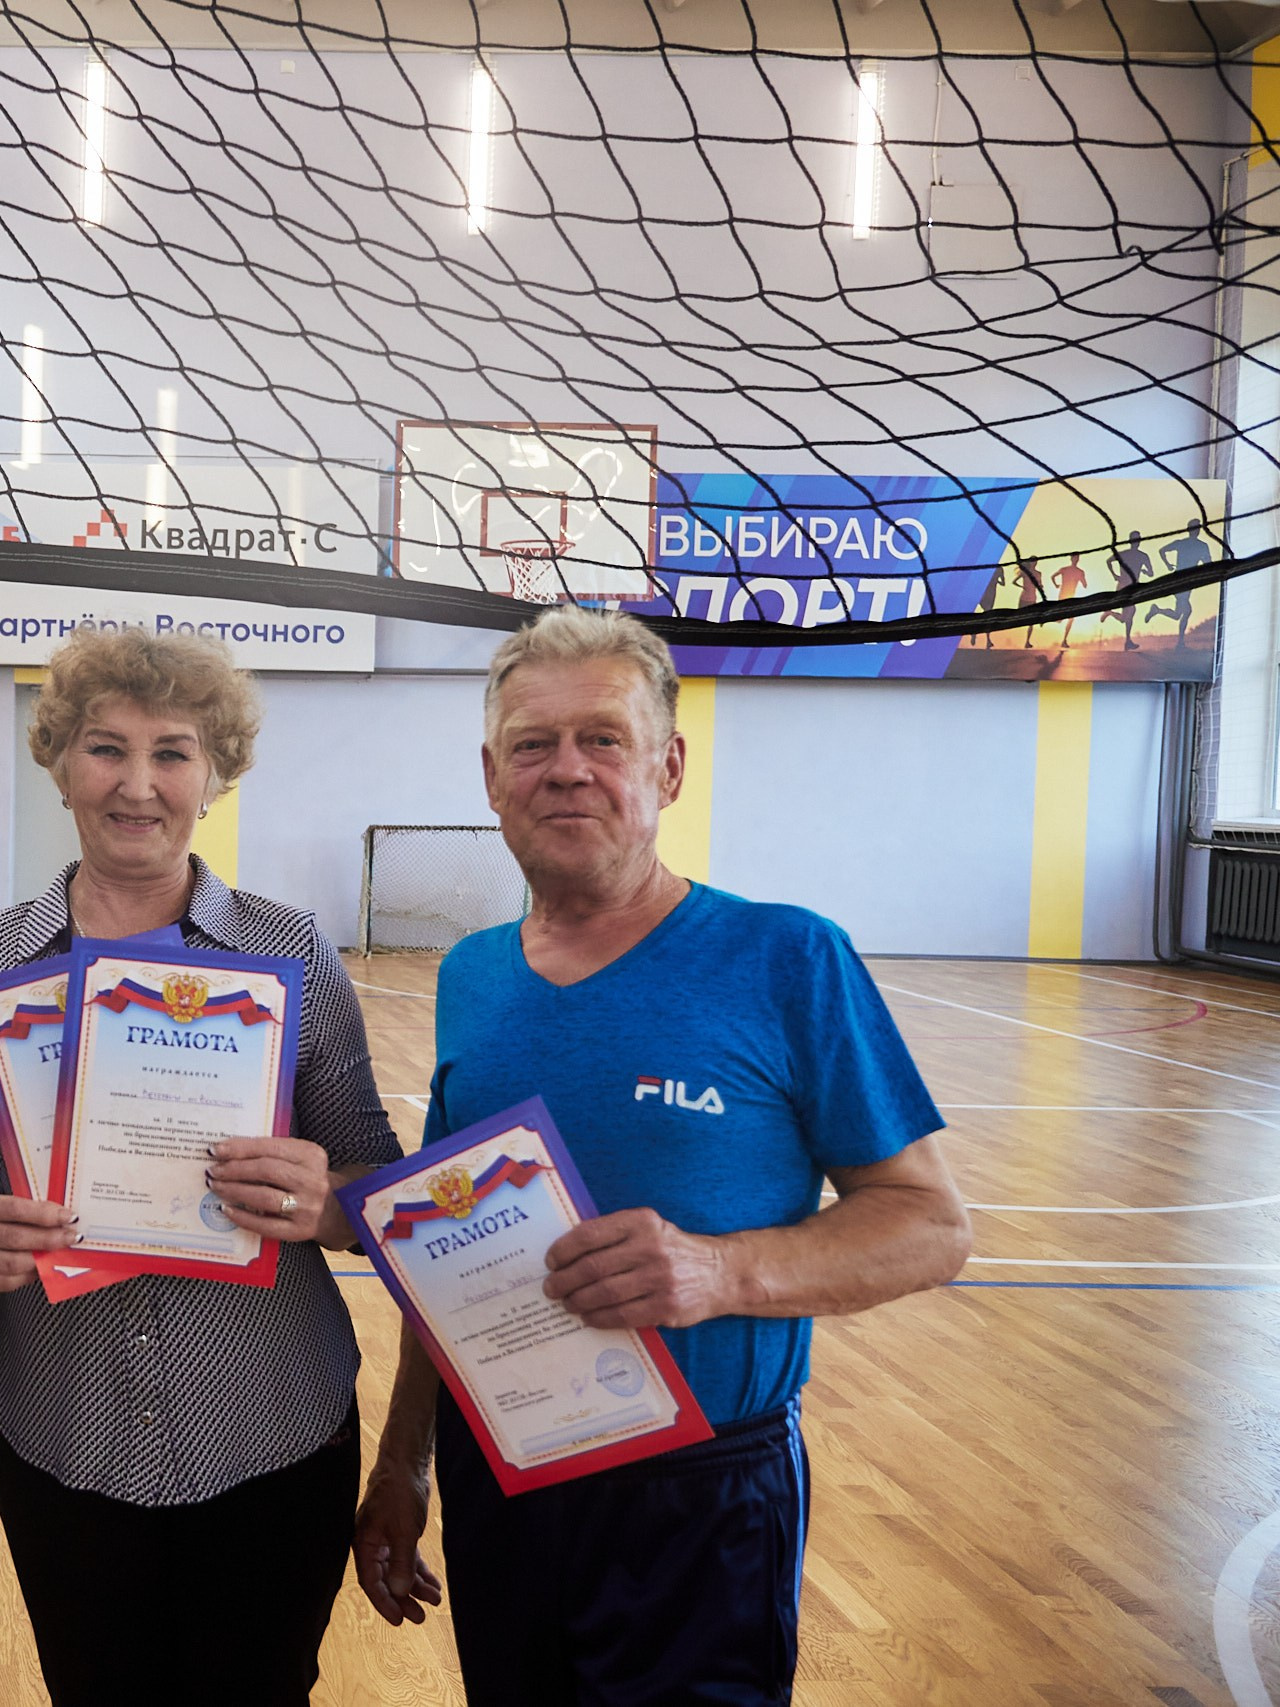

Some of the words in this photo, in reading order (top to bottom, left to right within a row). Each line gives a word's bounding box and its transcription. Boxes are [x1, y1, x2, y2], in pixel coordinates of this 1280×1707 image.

[659, 515, 929, 560] ВЫБИРАЮ
[155, 614, 346, 645] Восточного
[652, 577, 928, 647] ПОРТ!
[126, 1025, 239, 1054] ГРАМОТА
[634, 1075, 725, 1115] FILA
[424, 1204, 530, 1261] ГРАМОТА
